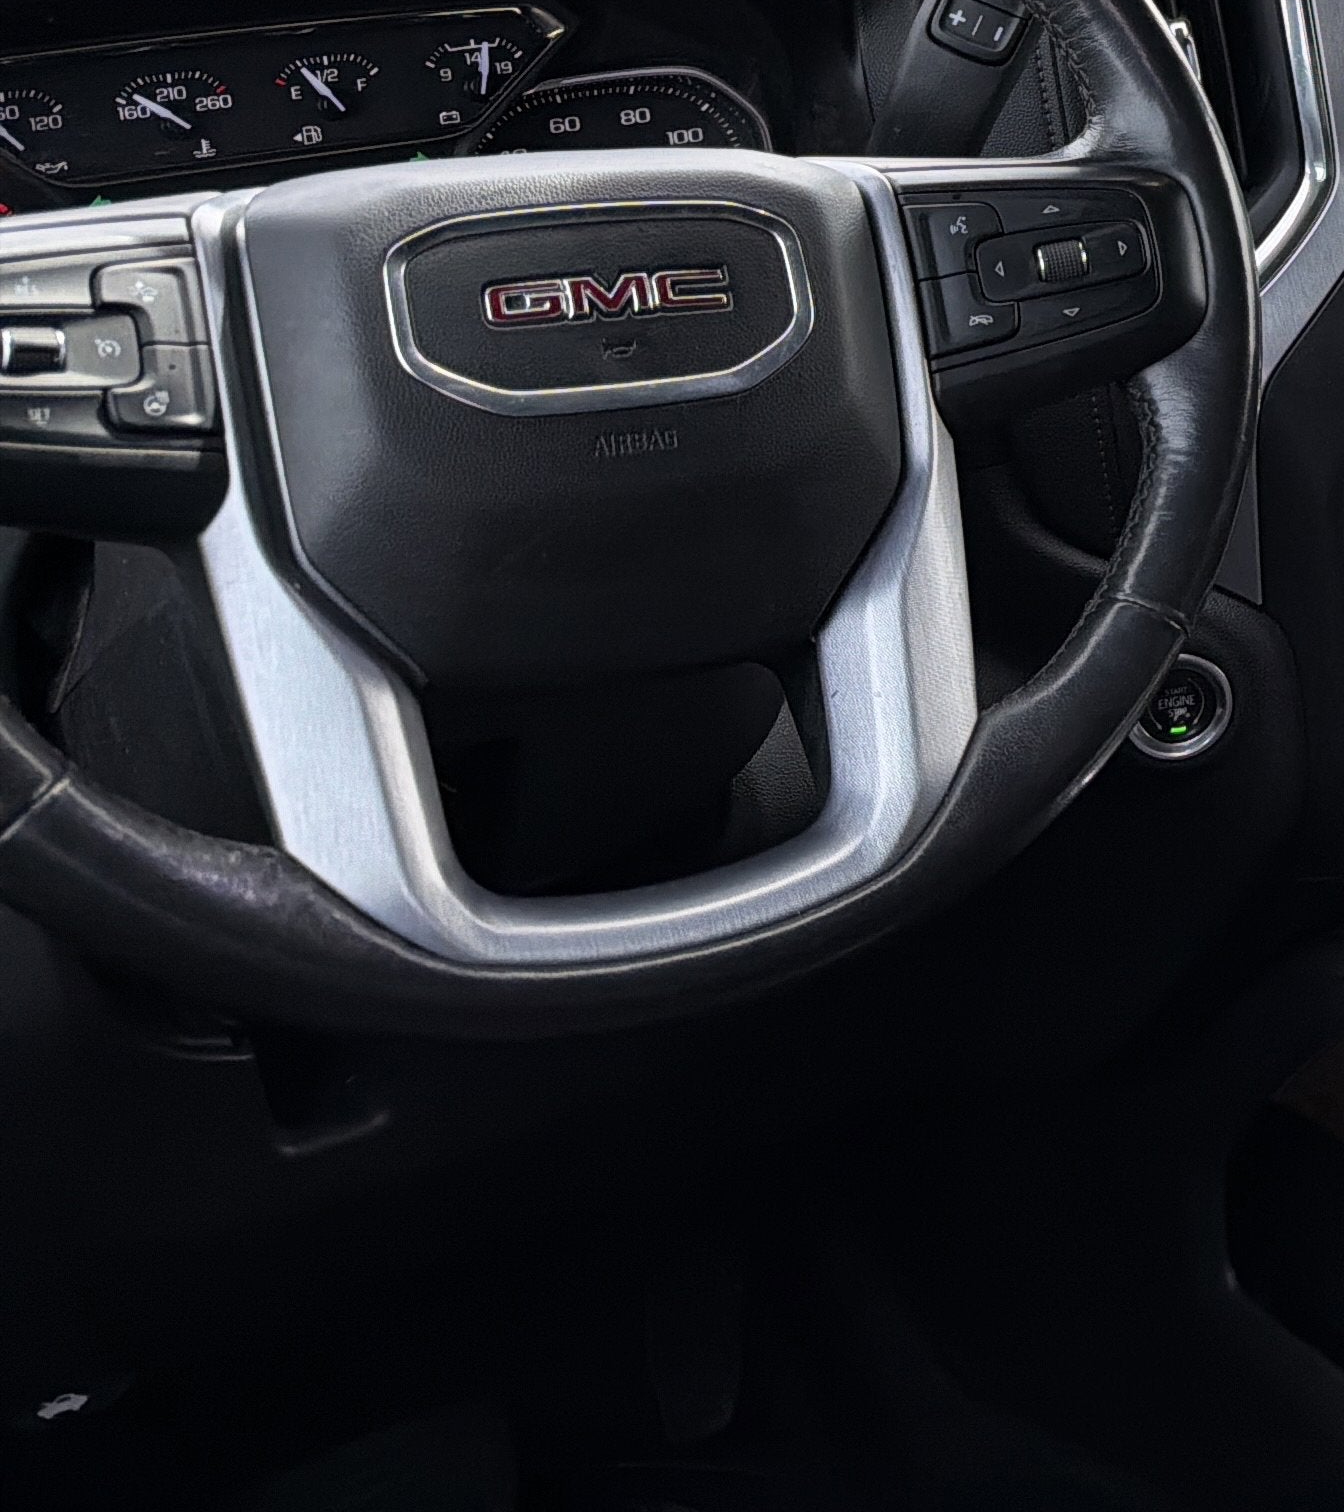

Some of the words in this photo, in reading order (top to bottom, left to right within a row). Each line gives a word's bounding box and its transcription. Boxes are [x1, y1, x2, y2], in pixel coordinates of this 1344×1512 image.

[464, 51, 481, 66] 14
[439, 68, 452, 82] 9
[494, 61, 513, 75] 19
[356, 77, 367, 92] F
[155, 86, 187, 102] 210
[291, 86, 302, 100] E
[195, 94, 233, 112] 260
[117, 105, 152, 121] 160
[620, 107, 651, 126] 80
[29, 114, 63, 131] 120
[549, 116, 581, 134] 60
[665, 127, 704, 146] 100
[484, 266, 732, 327] GMC
[593, 429, 678, 458] AIRBAG
[1158, 694, 1196, 709] ENGINE
